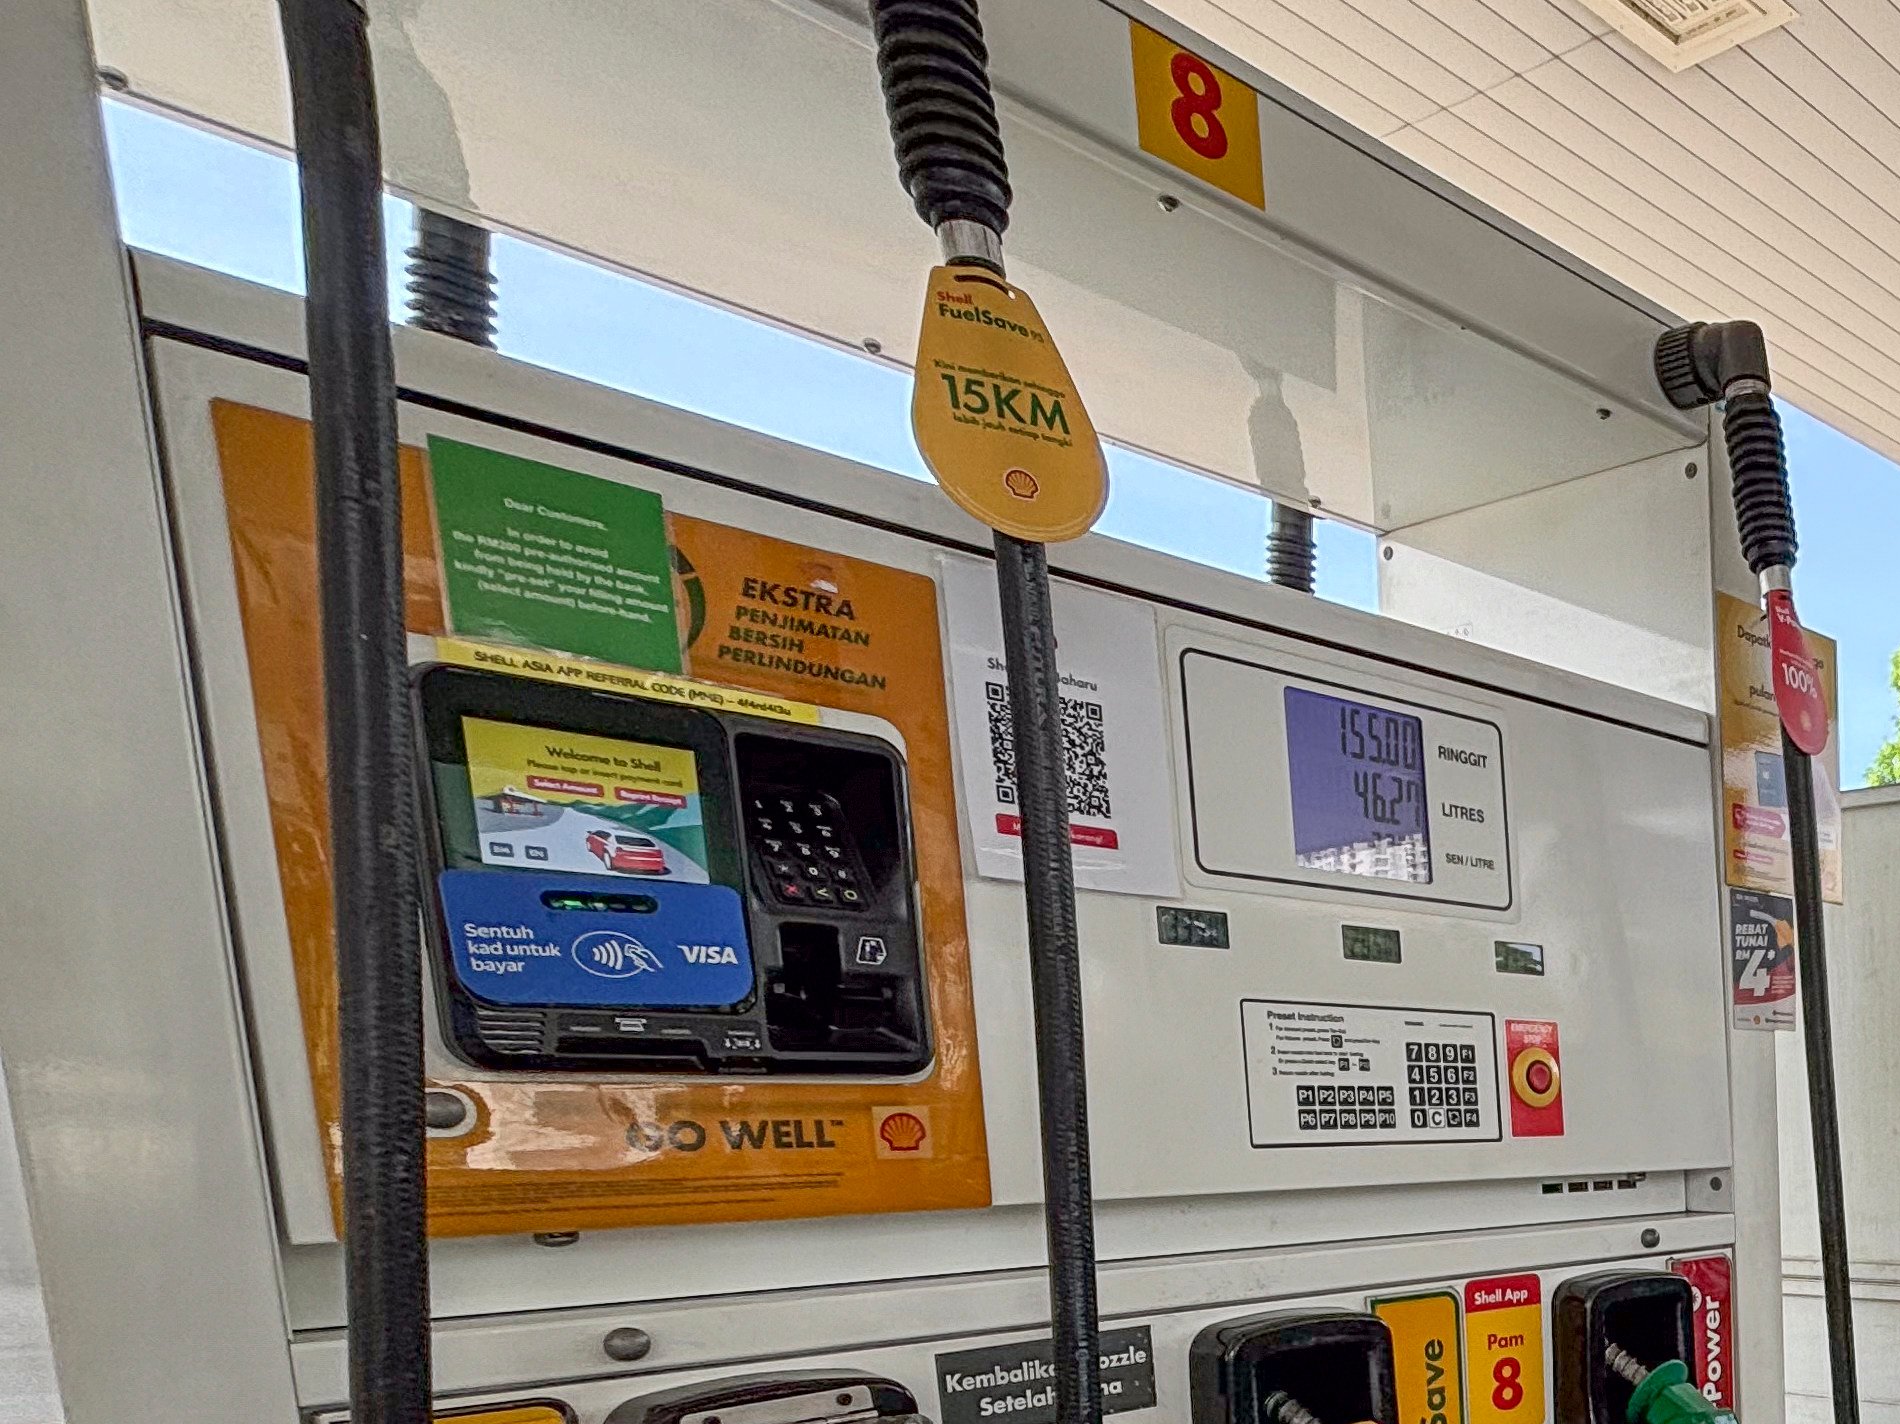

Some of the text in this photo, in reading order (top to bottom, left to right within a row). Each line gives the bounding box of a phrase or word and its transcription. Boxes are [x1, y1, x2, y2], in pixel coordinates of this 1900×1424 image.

[1170, 52, 1229, 160] 8
[936, 290, 973, 305] Shell
[938, 303, 1030, 339] FuelSave
[941, 373, 1071, 435] 15KM
[741, 577, 855, 621] EKSTRA
[735, 605, 871, 648] PENJIMATAN
[728, 625, 805, 654] BERSIH
[473, 650, 519, 671] SHELL
[522, 658, 554, 676] ASIA
[557, 664, 584, 682] APP
[585, 669, 648, 691] REFERRAL
[651, 680, 687, 699] CODE
[717, 644, 887, 691] PERLINDUNGAN
[1781, 662, 1818, 698] 100%
[545, 745, 662, 773] Welcome to Shell
[1438, 745, 1488, 769] RINGGIT
[1441, 802, 1485, 824] LITRES
[1445, 853, 1464, 866] SEN
[1470, 856, 1496, 870] LITRE
[463, 923, 535, 940] Sentuh
[1735, 923, 1768, 935] REBAT
[467, 941, 562, 958] kad untuk
[1735, 935, 1768, 948] TUNAI
[677, 945, 739, 965] VISA
[1735, 949, 1750, 961] RM
[470, 957, 526, 975] bayar
[1267, 1010, 1345, 1024] Preset Instruction
[1409, 1045, 1419, 1058] 7
[1427, 1046, 1437, 1060] 8
[1445, 1046, 1455, 1060] 9
[1411, 1068, 1421, 1081] 4
[1429, 1068, 1439, 1082] 5
[1447, 1068, 1456, 1082] 6
[1299, 1090, 1393, 1102] P1 P2 P3 P4 P5
[1431, 1090, 1440, 1104] 2
[1448, 1090, 1458, 1104] 3
[1300, 1113, 1396, 1126] P6 P7 P8 P9 P10
[1414, 1111, 1423, 1125] 0
[1431, 1111, 1442, 1126] C
[625, 1118, 706, 1152] GO
[1473, 1288, 1529, 1305] Shell App
[1487, 1332, 1525, 1351] Pam
[1703, 1295, 1722, 1404] Power
[945, 1346, 1148, 1393] Kembalika ozzle
[1491, 1356, 1524, 1410] 8
